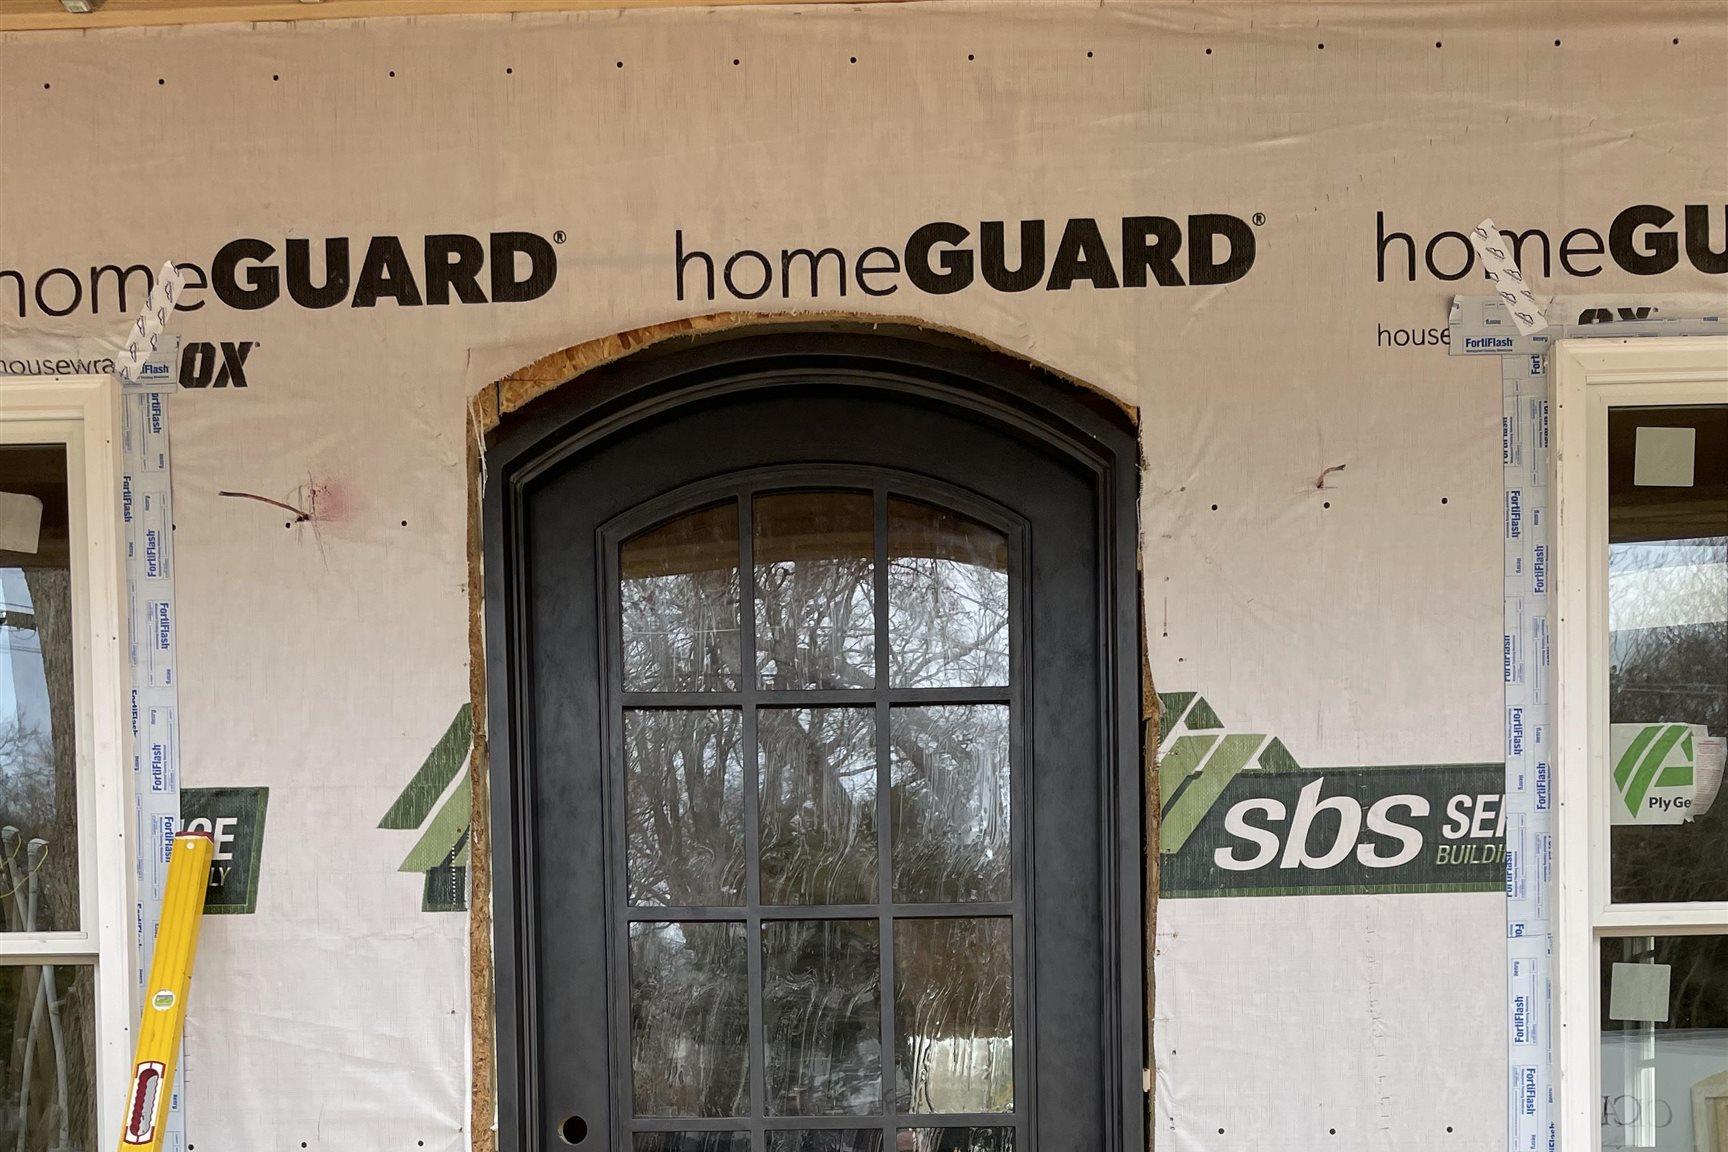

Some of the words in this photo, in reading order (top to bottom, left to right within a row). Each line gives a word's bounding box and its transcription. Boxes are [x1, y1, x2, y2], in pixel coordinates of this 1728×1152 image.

[179, 341, 253, 388] OX
[1465, 337, 1513, 348] FortiFlash
[1511, 491, 1520, 538] FortiFlash
[147, 530, 157, 577] FortiFlash
[1535, 545, 1544, 593] FortiFlash
[160, 602, 170, 649] FortiFlash
[1513, 708, 1523, 755] FortiFlash
[152, 744, 162, 791] FortiFlash
[1537, 762, 1546, 810] FortiFlash
[1214, 777, 1430, 871] sbs
[1515, 996, 1524, 1043] FortiFlash
[1527, 1068, 1536, 1115] FortiFlash
